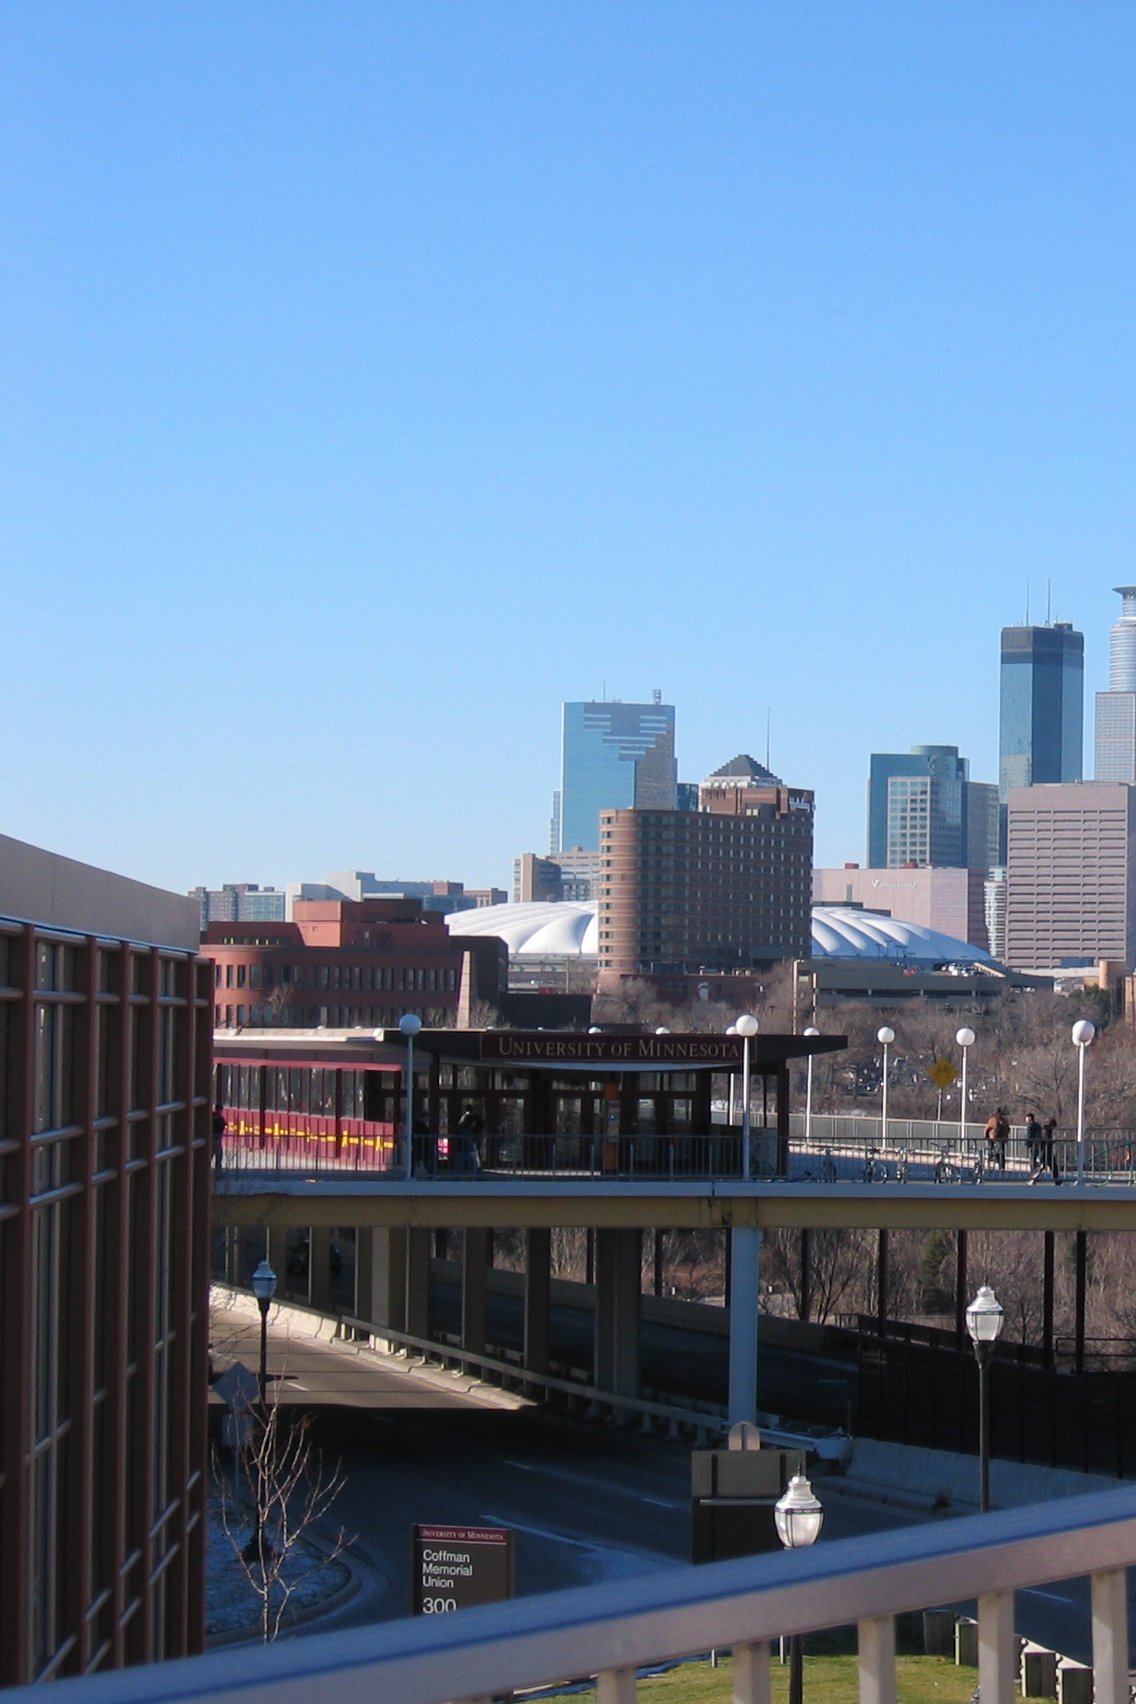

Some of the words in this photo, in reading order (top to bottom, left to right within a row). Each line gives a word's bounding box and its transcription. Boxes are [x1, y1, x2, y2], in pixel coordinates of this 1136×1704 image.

[498, 1037, 606, 1057] UNIVERSITY
[610, 1043, 632, 1058] OF
[638, 1039, 740, 1058] MINNESOTA
[421, 1529, 456, 1539] UNIVERSITY
[467, 1531, 504, 1541] MINNESOTA
[423, 1549, 470, 1563] Coffman
[422, 1563, 473, 1576] Memorial
[422, 1576, 454, 1588] Union
[422, 1598, 457, 1614] 300
